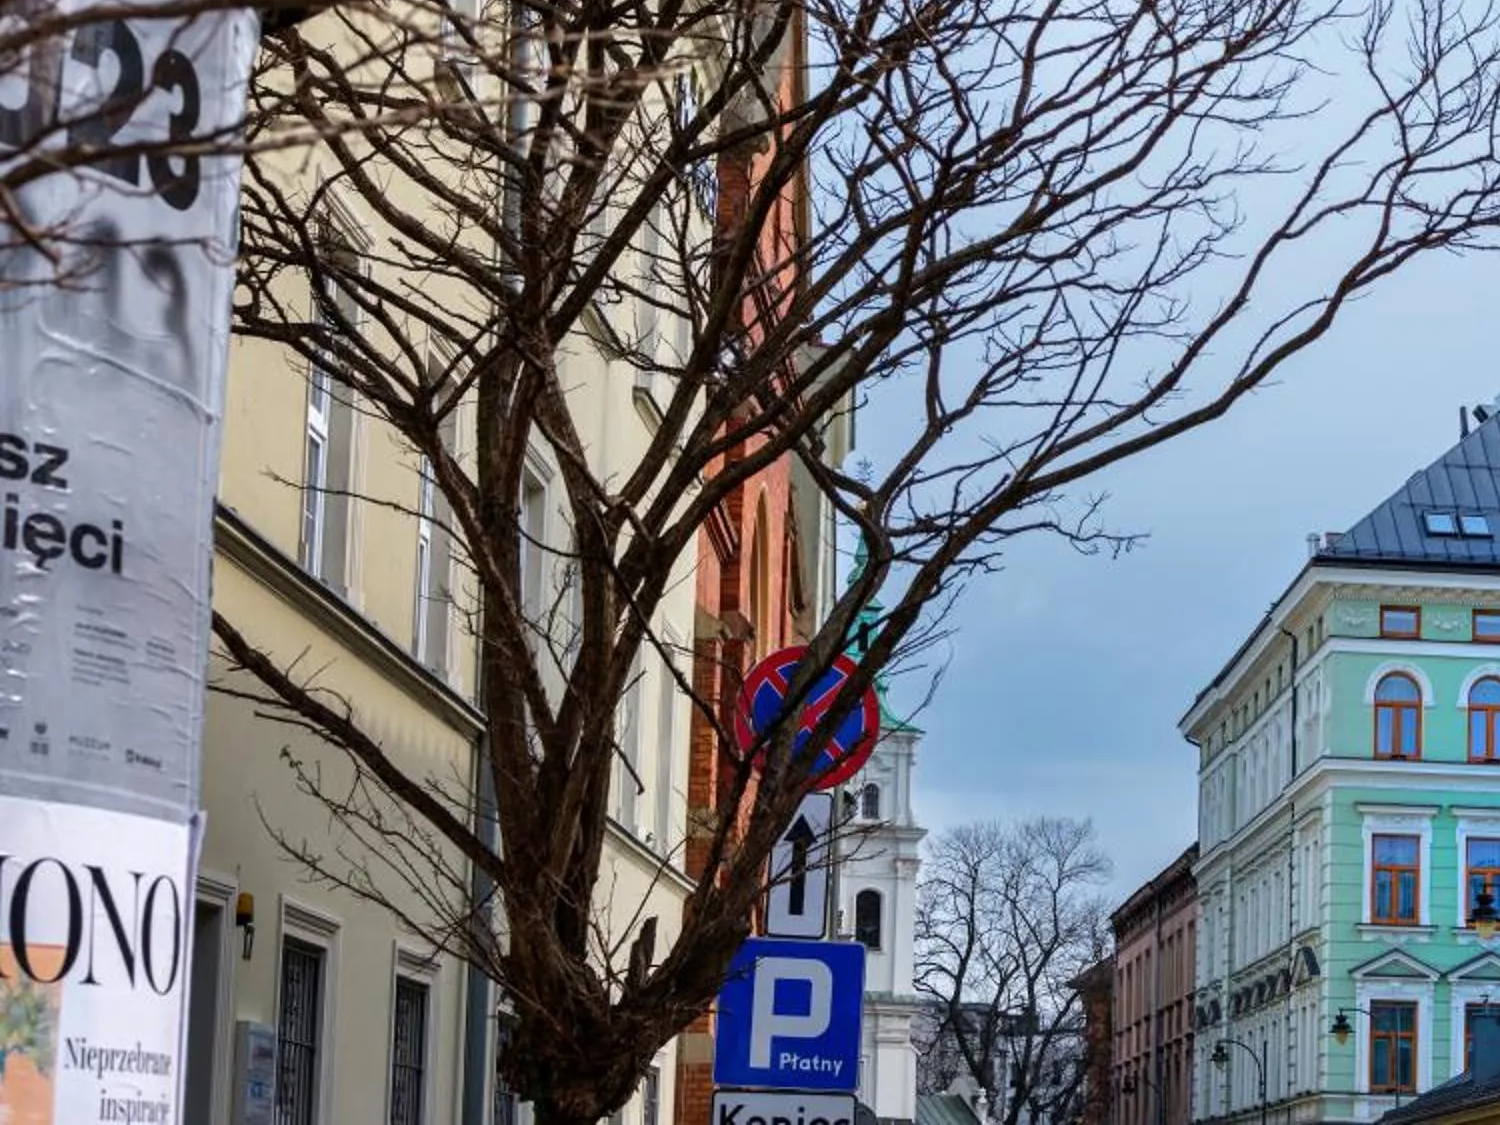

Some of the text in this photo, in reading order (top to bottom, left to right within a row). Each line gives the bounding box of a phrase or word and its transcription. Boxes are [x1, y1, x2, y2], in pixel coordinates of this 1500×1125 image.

[0, 433, 69, 488] sz
[3, 493, 123, 574] ięci
[0, 854, 181, 996] ONO
[750, 956, 833, 1068] P
[779, 1052, 843, 1077] Płatny
